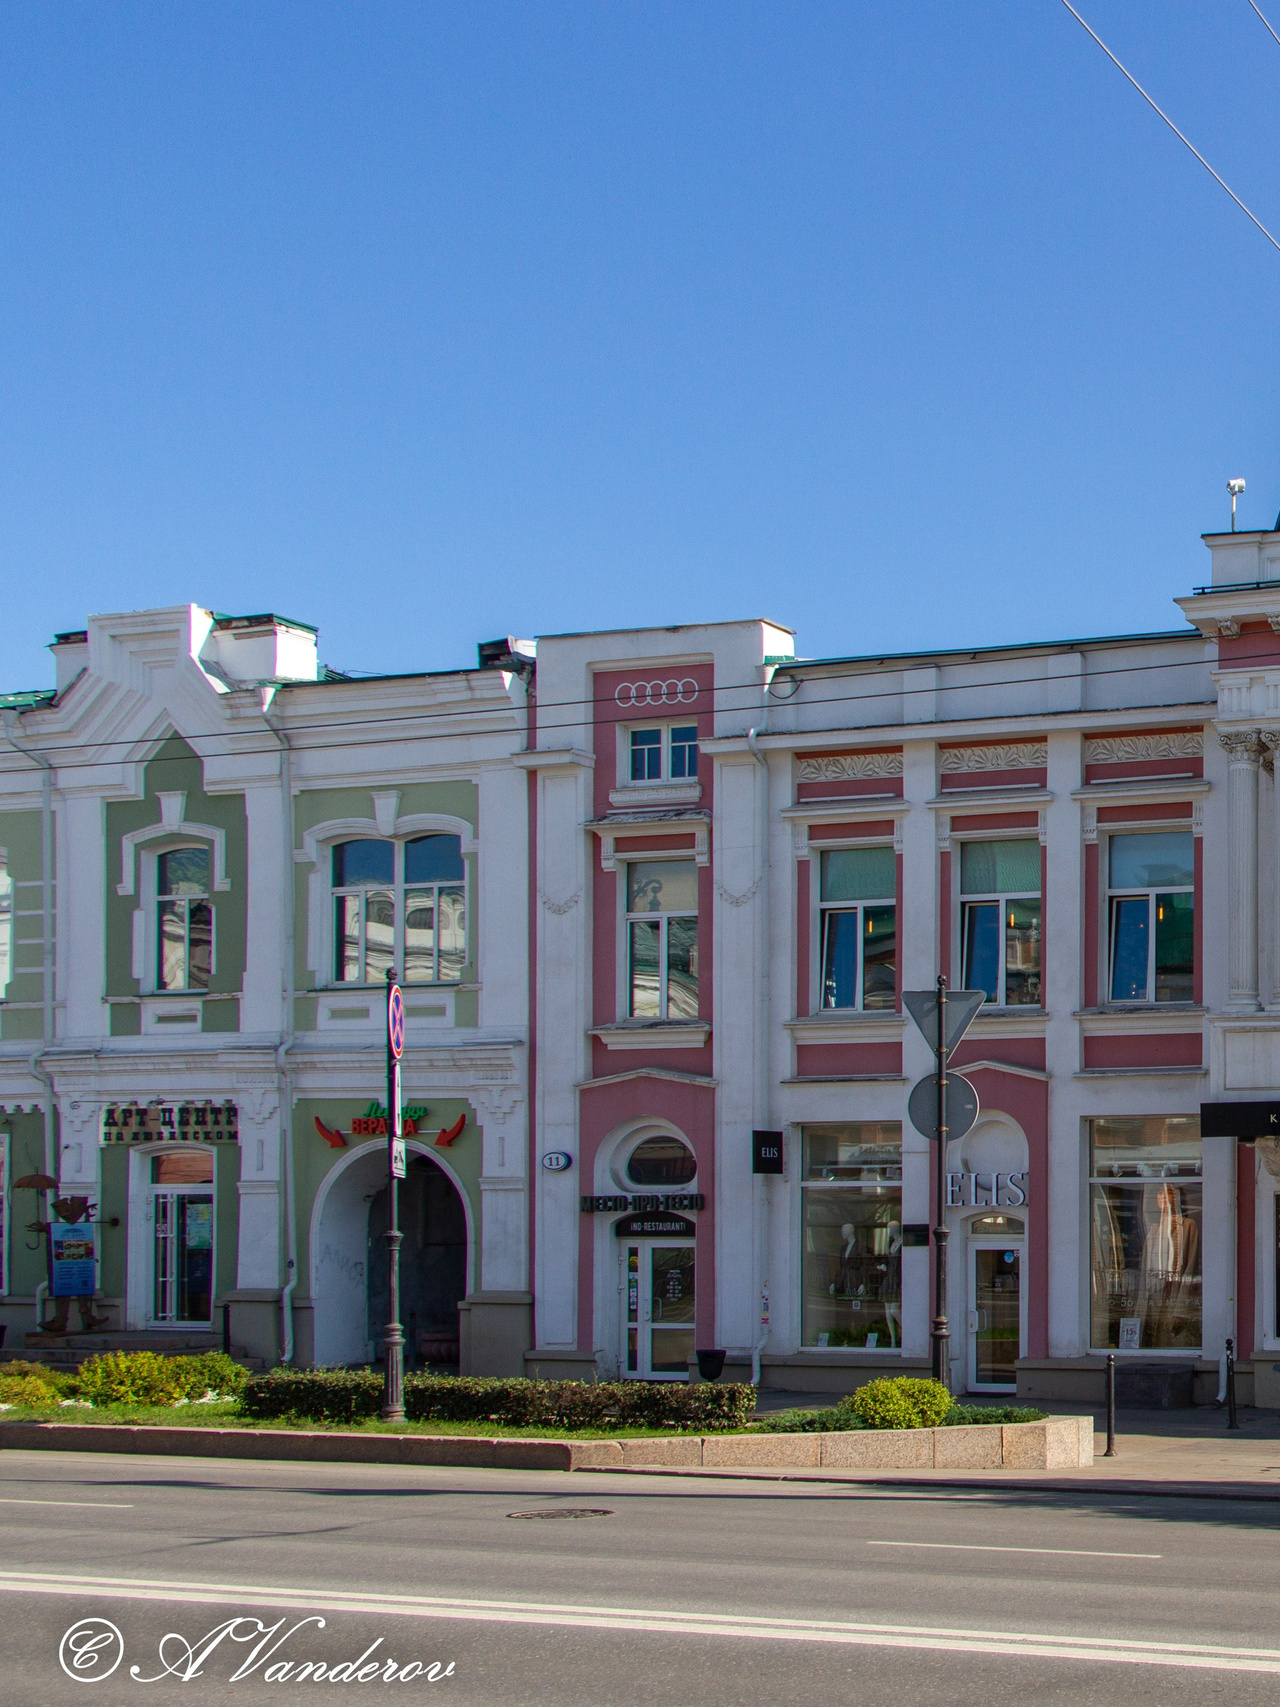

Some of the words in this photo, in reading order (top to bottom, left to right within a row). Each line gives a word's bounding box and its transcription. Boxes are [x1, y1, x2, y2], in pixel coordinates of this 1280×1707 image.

[104, 1107, 239, 1129] АРТ-ЦЕНТР
[762, 1147, 779, 1158] ELIS
[547, 1156, 563, 1167] 11
[946, 1172, 1027, 1207] ELIS
[1121, 1297, 1135, 1307] 56
